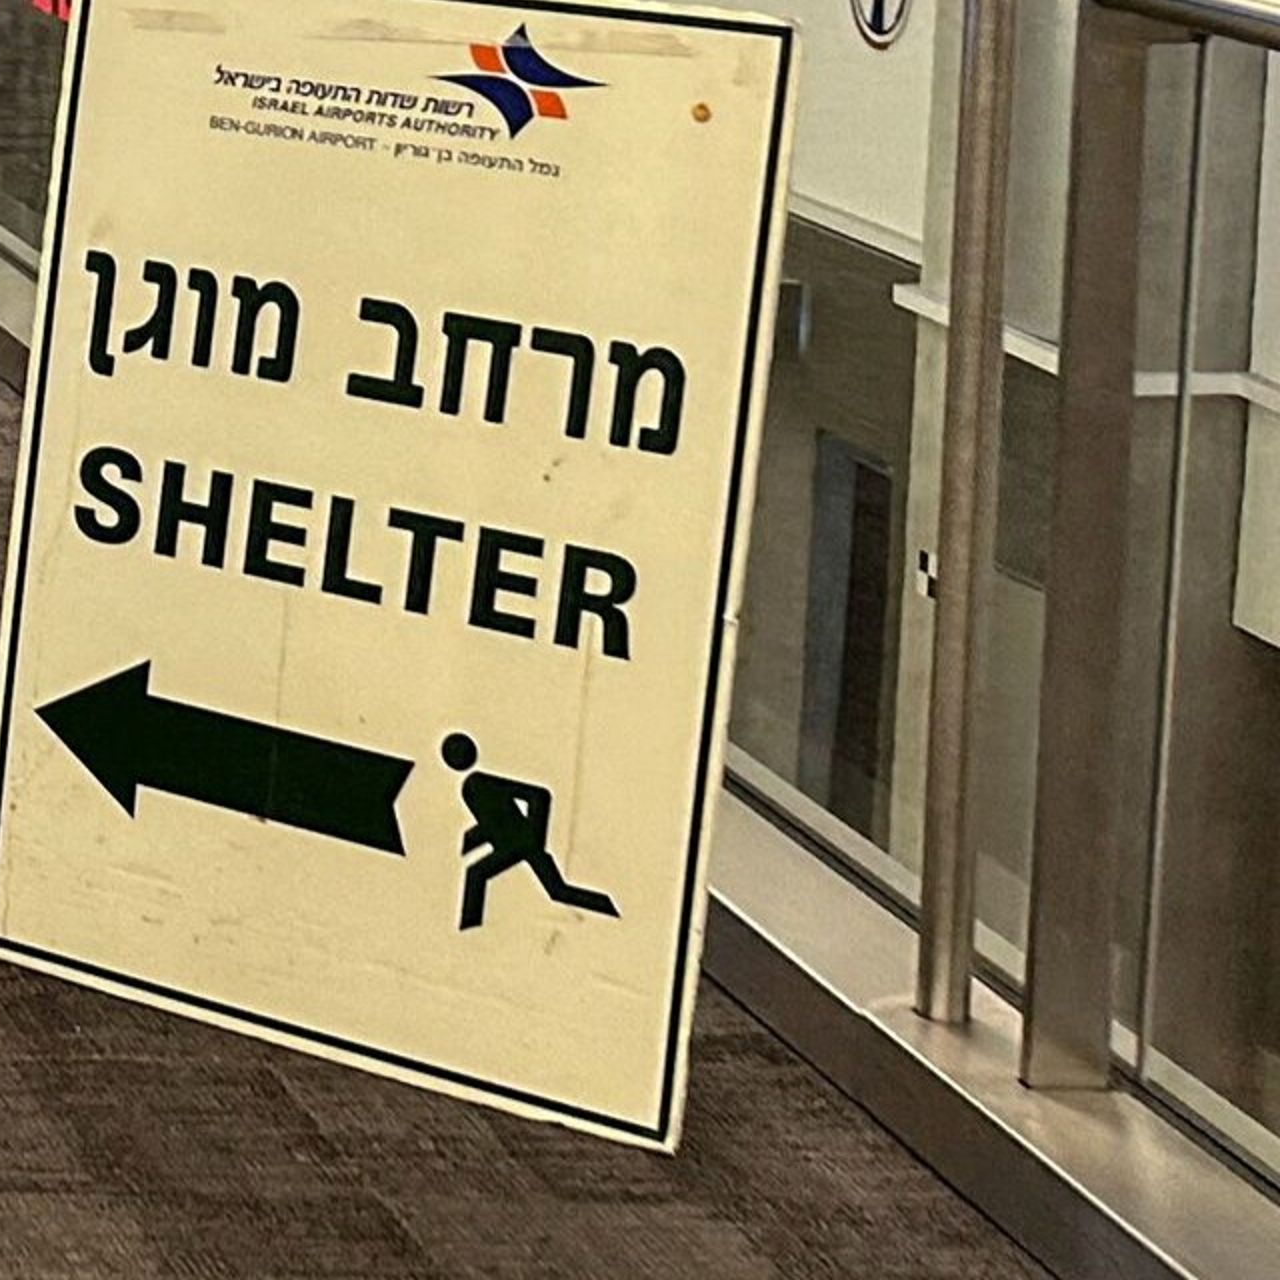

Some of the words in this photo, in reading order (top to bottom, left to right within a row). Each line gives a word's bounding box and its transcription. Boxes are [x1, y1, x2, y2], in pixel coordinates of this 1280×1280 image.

[214, 63, 282, 93] בישראל
[286, 79, 361, 104] התעופה
[365, 88, 418, 110] שדות
[421, 96, 475, 119] רשות
[209, 115, 305, 141] BEN-GURION
[307, 130, 378, 151] AIRPORT
[251, 96, 309, 116] ISRAEL
[313, 104, 398, 129] AIRPORTS
[400, 117, 501, 141] AUTHORITY
[457, 150, 524, 172] התעופה
[528, 158, 561, 177] נמל
[84, 249, 301, 383] מוגן
[346, 297, 686, 456] מרחב
[73, 445, 638, 661] SHELTER
